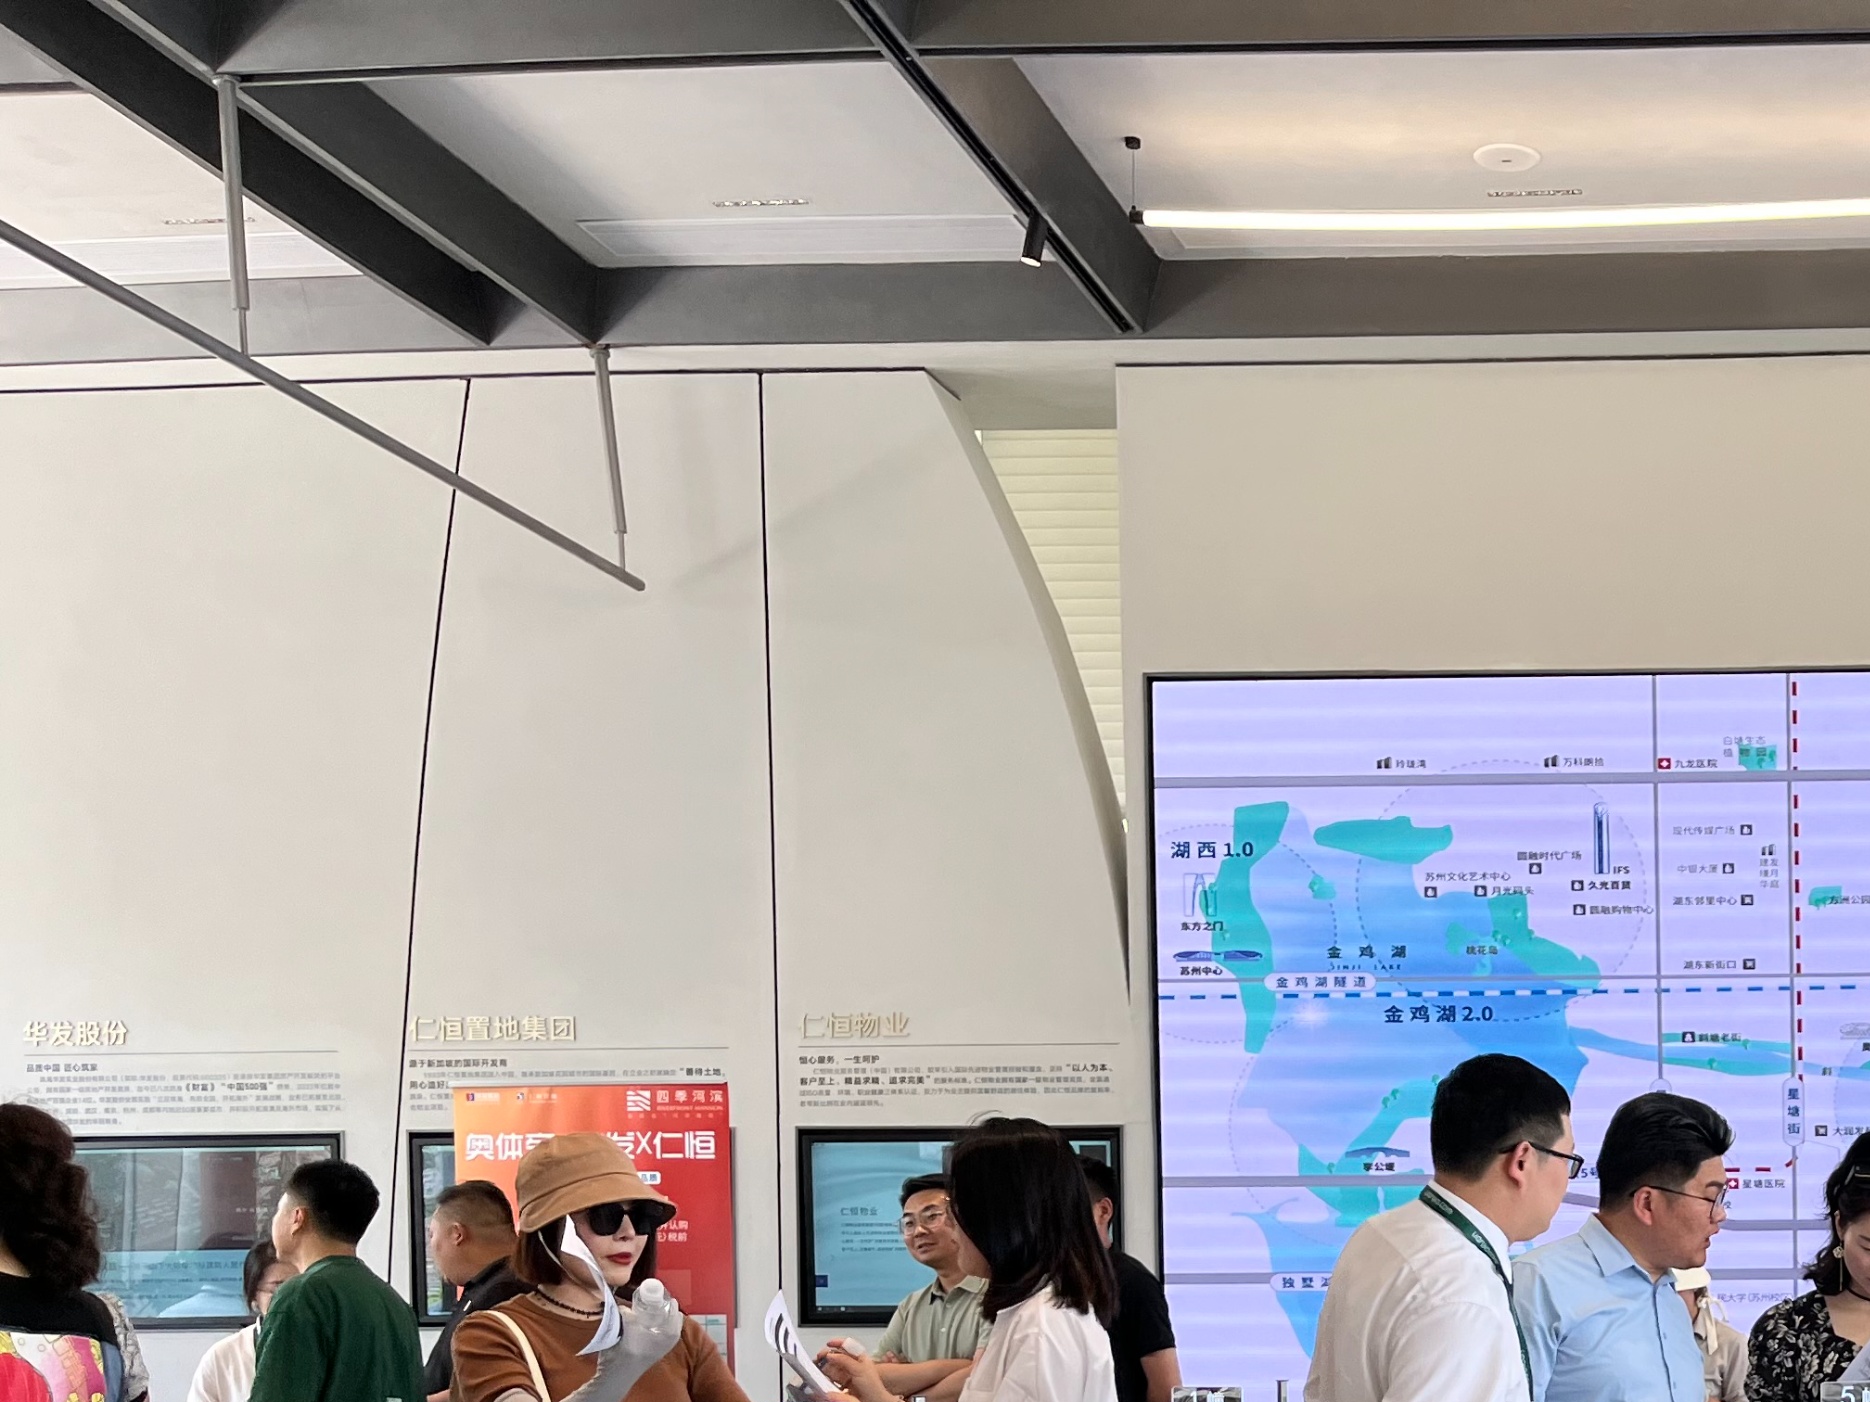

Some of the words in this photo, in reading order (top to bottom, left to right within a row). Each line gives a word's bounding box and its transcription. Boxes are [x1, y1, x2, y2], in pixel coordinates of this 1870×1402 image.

[1674, 759, 1718, 769] 九龙医院
[1613, 866, 1630, 874] IFS
[1425, 872, 1510, 881] 苏州文化艺术中心
[1491, 886, 1534, 895] 月光码头
[1588, 881, 1631, 891] 久光百货
[1673, 896, 1738, 905] 湖东邻里中心
[1181, 921, 1223, 932] 东方之门
[1327, 945, 1406, 959] 金鸡湖
[1466, 945, 1498, 955] 桃花岛
[1683, 960, 1737, 970] 湖东新街口
[1180, 966, 1223, 976] 苏州中心
[1276, 976, 1366, 988] 金鸡湖隧道
[1384, 1005, 1494, 1023] 金鸡湖2.0
[409, 1015, 577, 1042] 仁恒置地集团
[799, 1011, 910, 1039] 仁恒物业
[22, 1020, 128, 1047] 华发股份
[26, 1063, 61, 1073] 品质中国
[656, 1089, 724, 1103] 四季河滨
[1788, 1088, 1800, 1135] 星塘街
[1742, 1178, 1785, 1189] 星塘医院
[840, 1207, 879, 1216] 仁恒物业
